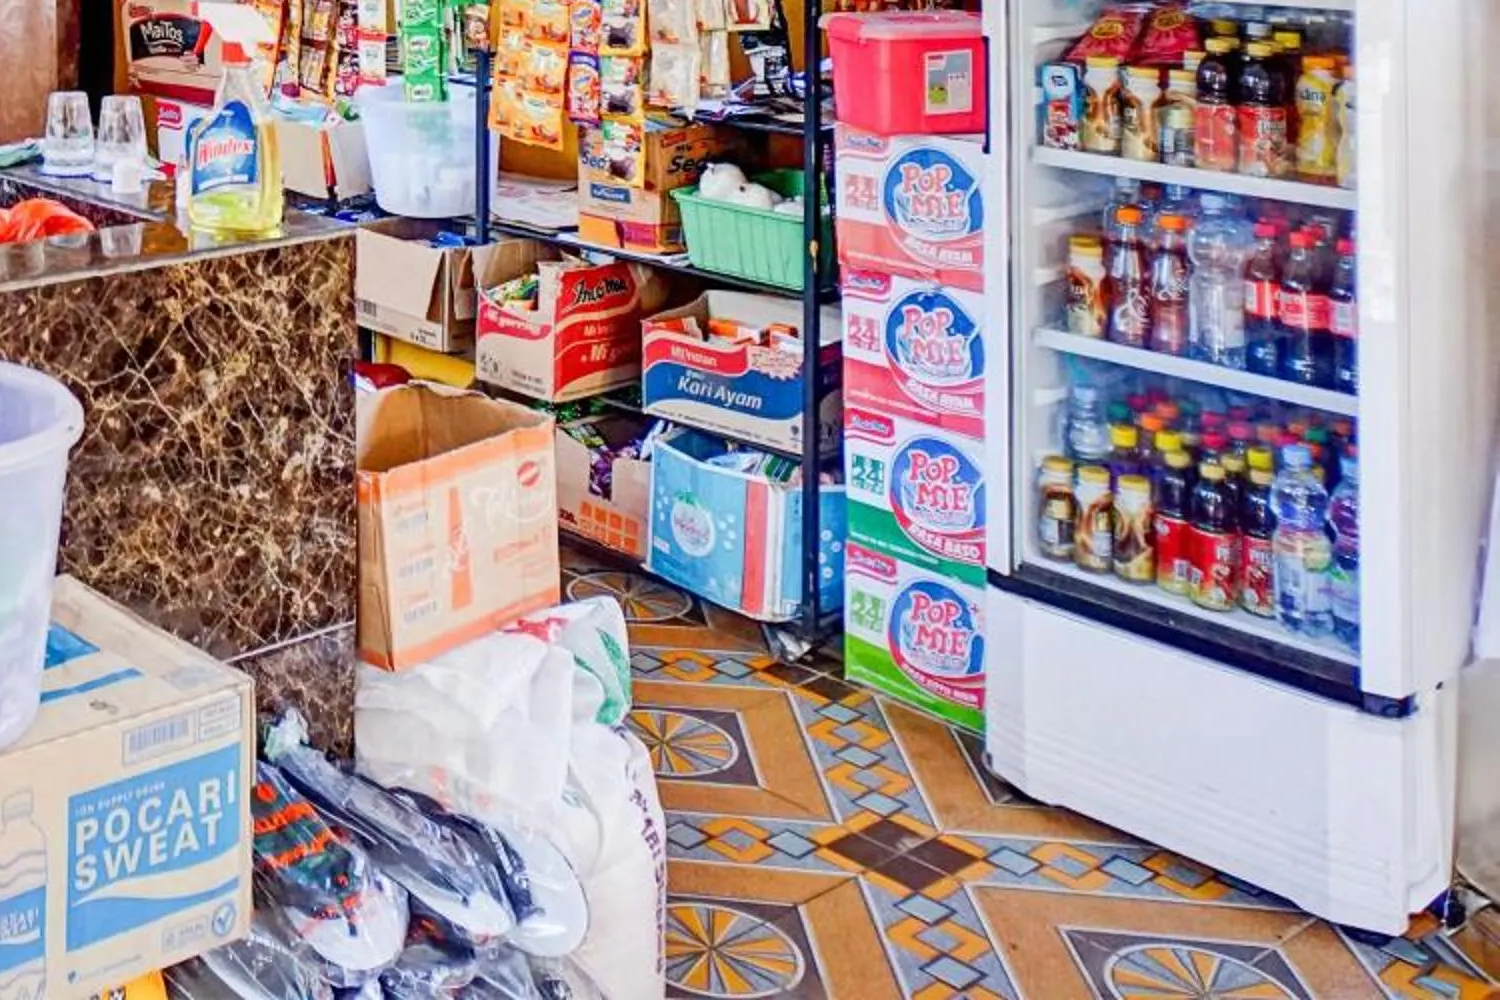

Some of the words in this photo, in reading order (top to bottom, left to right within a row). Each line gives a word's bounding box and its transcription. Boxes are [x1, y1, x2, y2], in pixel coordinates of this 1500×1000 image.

[901, 164, 953, 194] POP
[911, 192, 966, 219] MIE
[902, 306, 954, 338] POP
[912, 337, 965, 366] MIE
[677, 375, 713, 400] Kari
[713, 385, 764, 412] Ayam
[908, 451, 959, 484] POP
[915, 483, 970, 512] MIE
[911, 592, 961, 625] POP
[914, 625, 968, 657] MIE
[74, 768, 236, 858] POCARI
[74, 811, 223, 892] SWEAT
